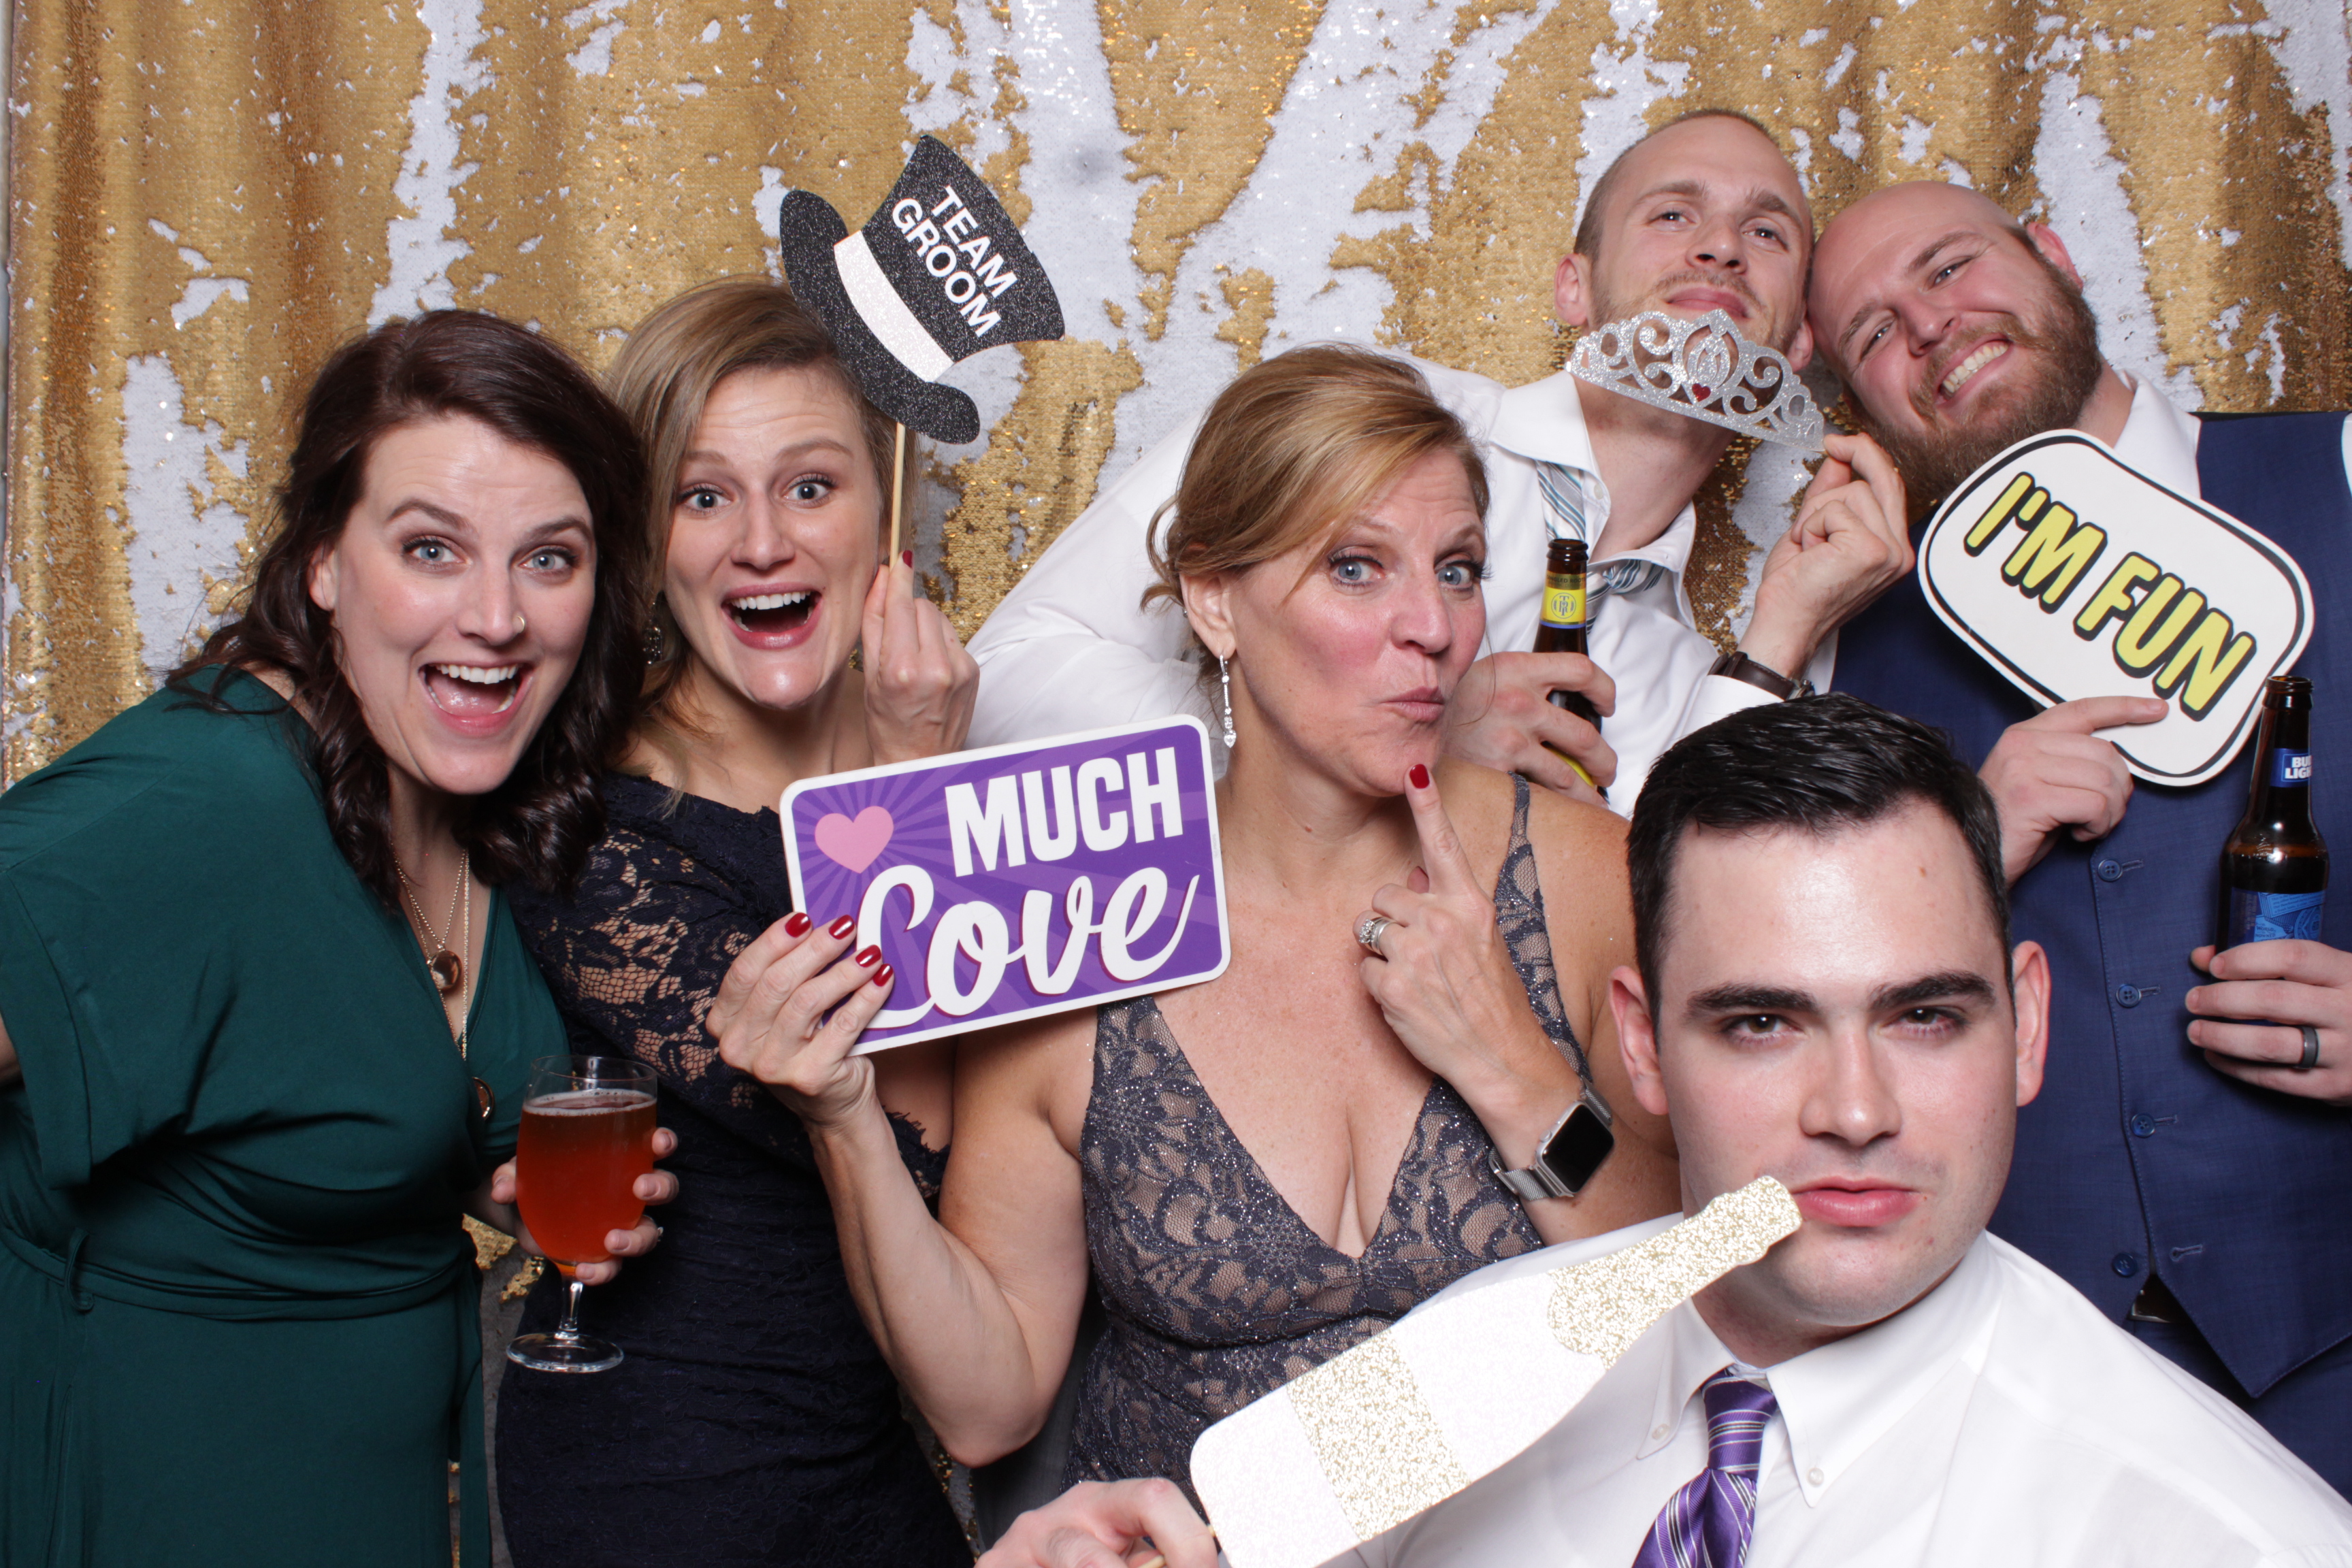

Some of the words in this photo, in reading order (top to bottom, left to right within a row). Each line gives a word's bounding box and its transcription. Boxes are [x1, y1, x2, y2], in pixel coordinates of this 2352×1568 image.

[892, 197, 1002, 338] GROOM
[931, 185, 1018, 299] TEAM
[1963, 472, 2108, 615] I'M
[2073, 552, 2257, 722] FUN
[945, 747, 1183, 877] MUCH
[856, 864, 1200, 1030] Love
